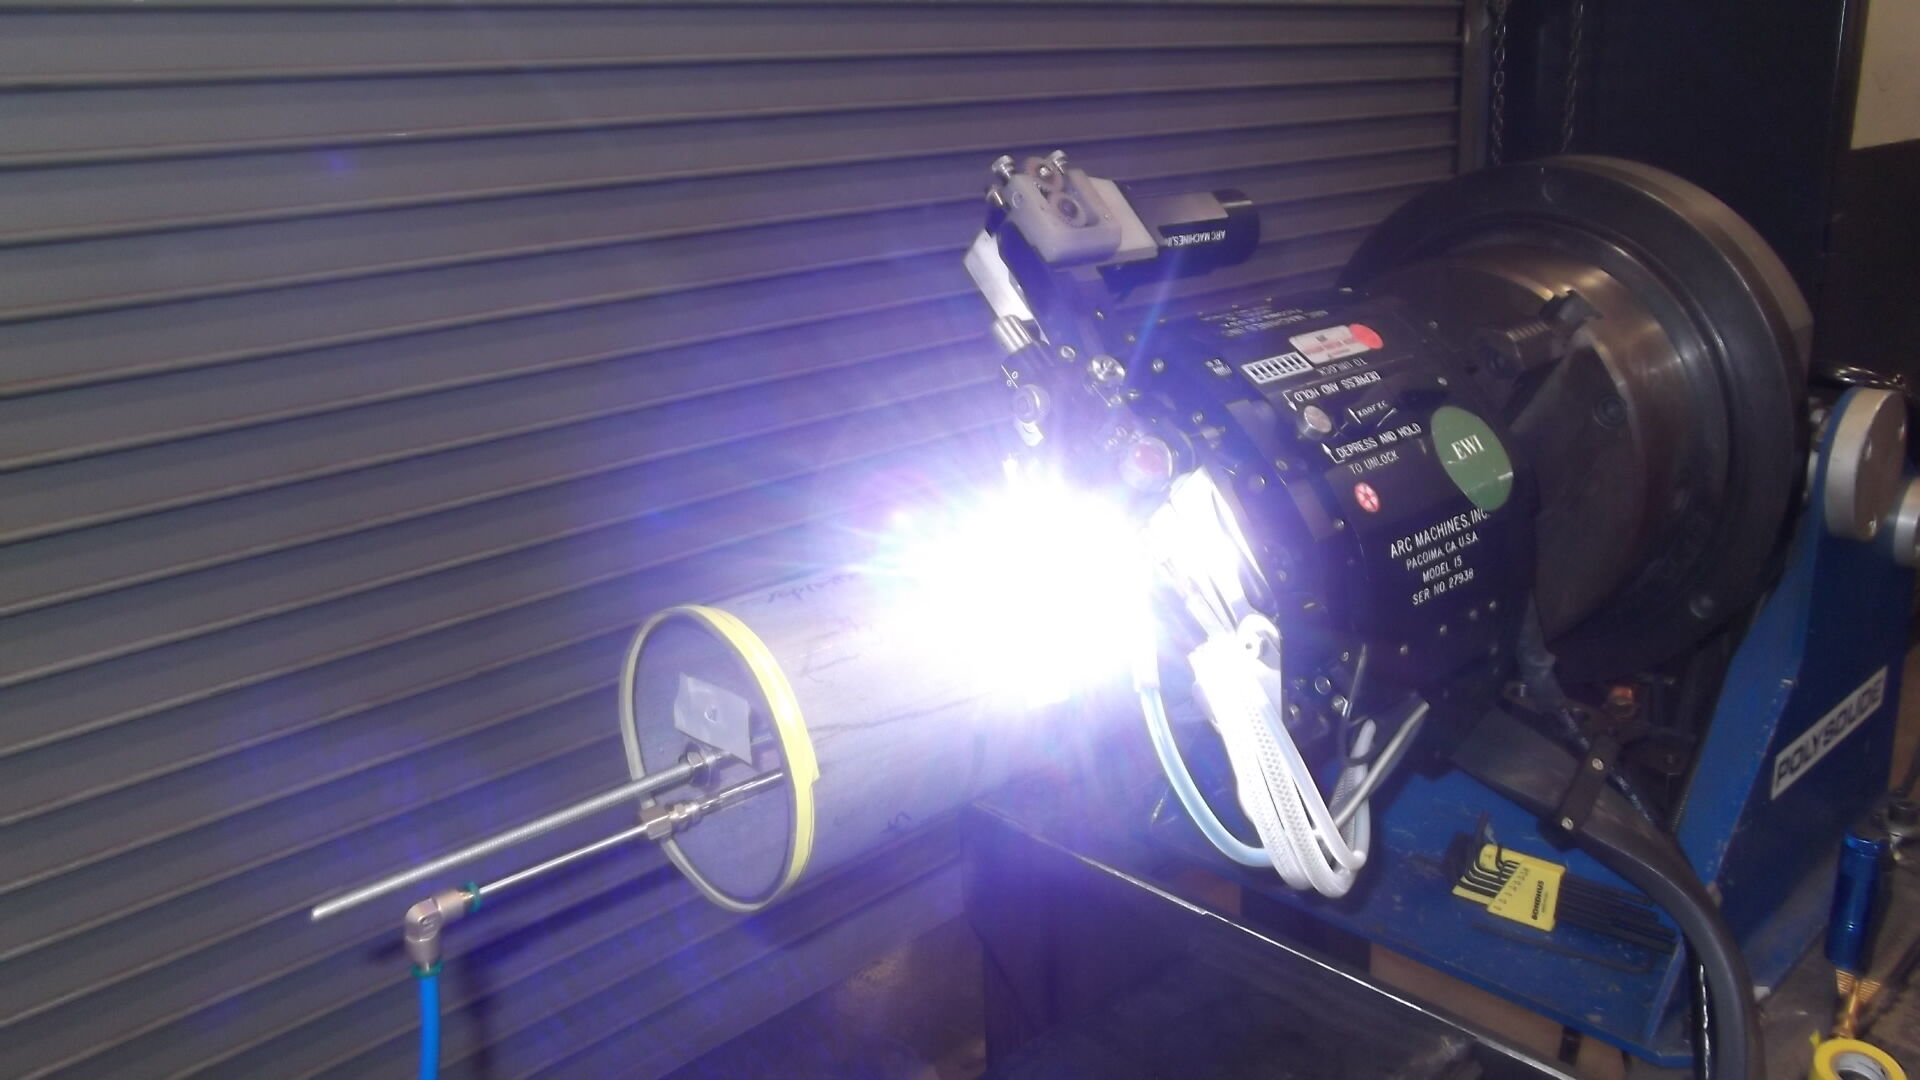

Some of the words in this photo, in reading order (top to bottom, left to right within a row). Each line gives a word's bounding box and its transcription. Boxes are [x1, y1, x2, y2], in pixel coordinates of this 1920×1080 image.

[1210, 229, 1226, 241] ARC
[1320, 382, 1340, 395] AND
[1342, 370, 1382, 391] DEPRESS
[1294, 388, 1320, 402] HOLD
[1335, 437, 1378, 459] DEPRESS
[1378, 430, 1398, 445] AND
[1396, 422, 1422, 438] HOLD
[1451, 434, 1484, 460] EWI
[1348, 462, 1363, 476] TO
[1363, 449, 1399, 470] UNLOCK
[1390, 536, 1413, 559] ARC
[1422, 561, 1450, 583] MODEL
[1453, 554, 1463, 568] 15
[1412, 588, 1431, 606] SER
[1448, 567, 1474, 589] 27938
[1776, 674, 1884, 790] POLYSOUDE
[1531, 879, 1545, 921] BONDHUS
